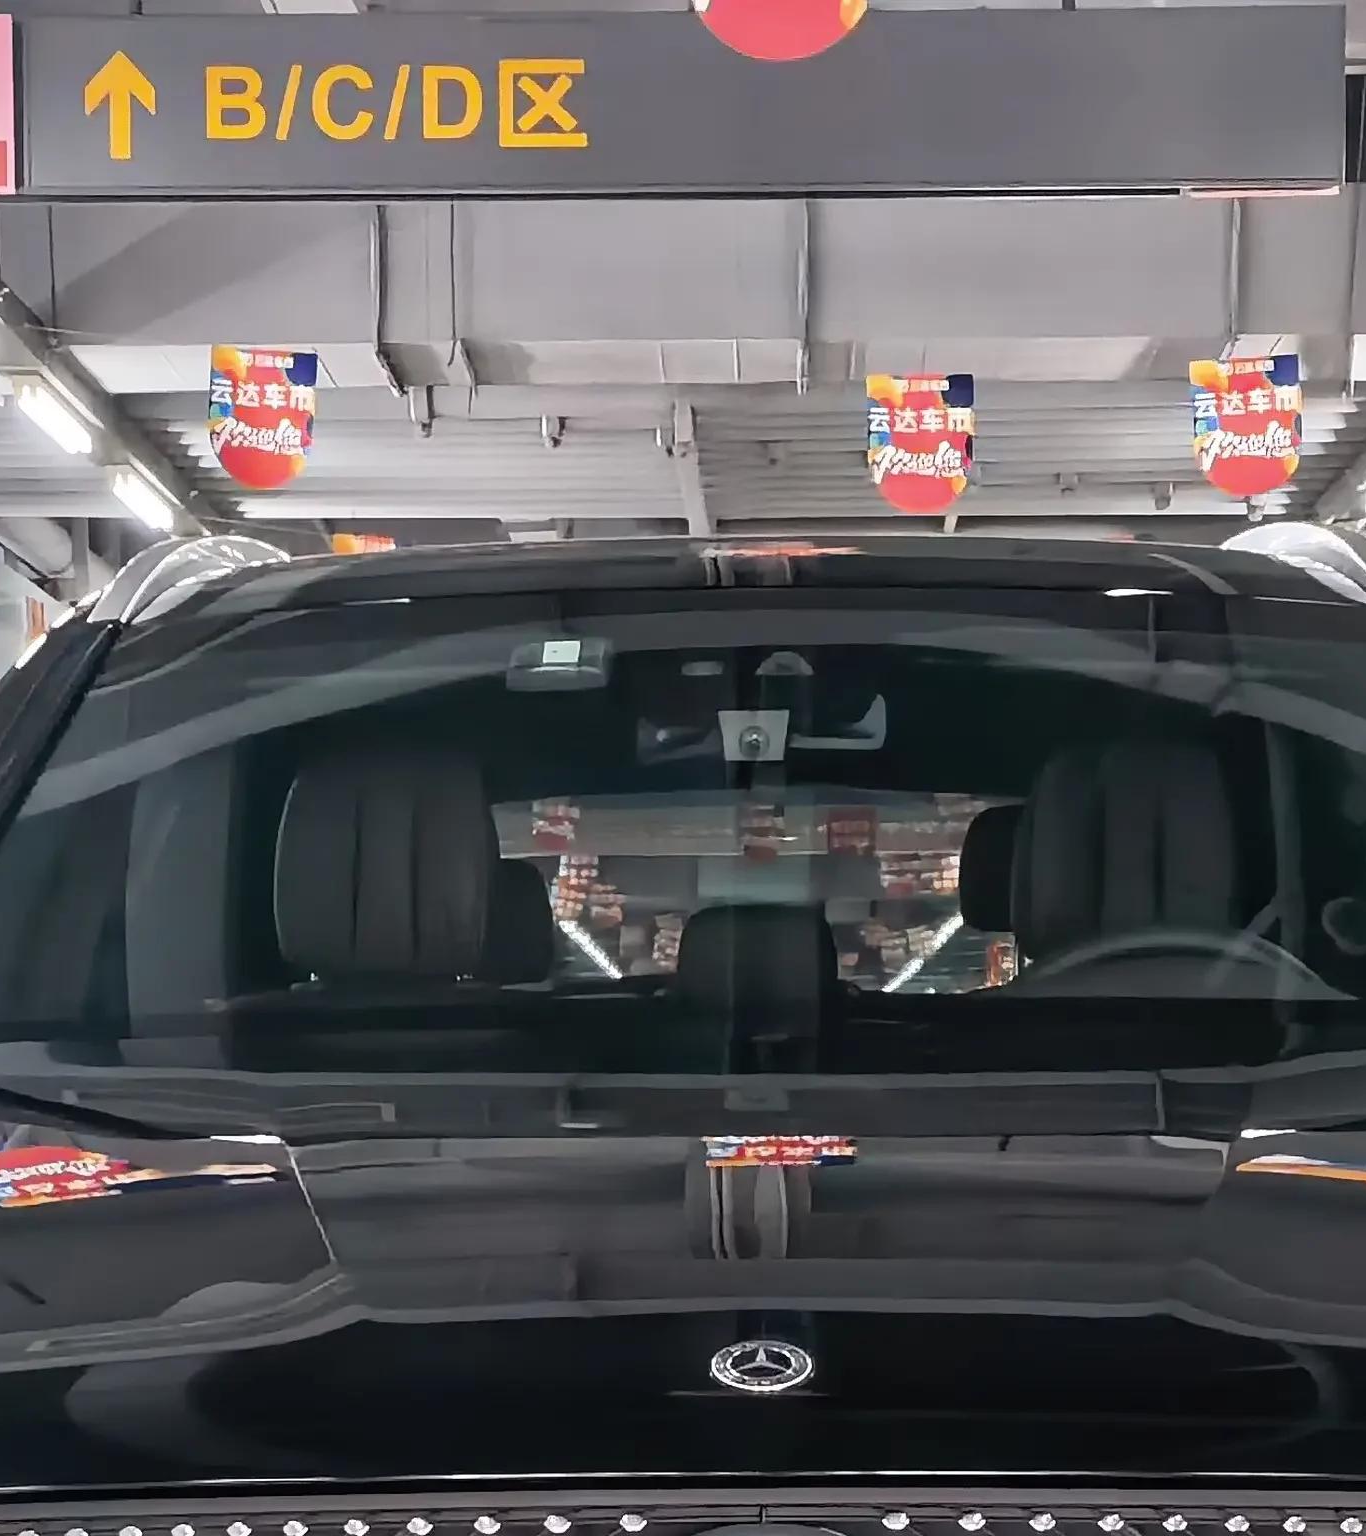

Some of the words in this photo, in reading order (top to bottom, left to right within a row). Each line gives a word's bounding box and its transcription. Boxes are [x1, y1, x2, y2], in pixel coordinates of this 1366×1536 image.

[205, 58, 588, 148] B/C/D区
[211, 379, 315, 413] 云达车市
[1194, 386, 1303, 415] 云达车市
[868, 407, 975, 434] 云达车市
